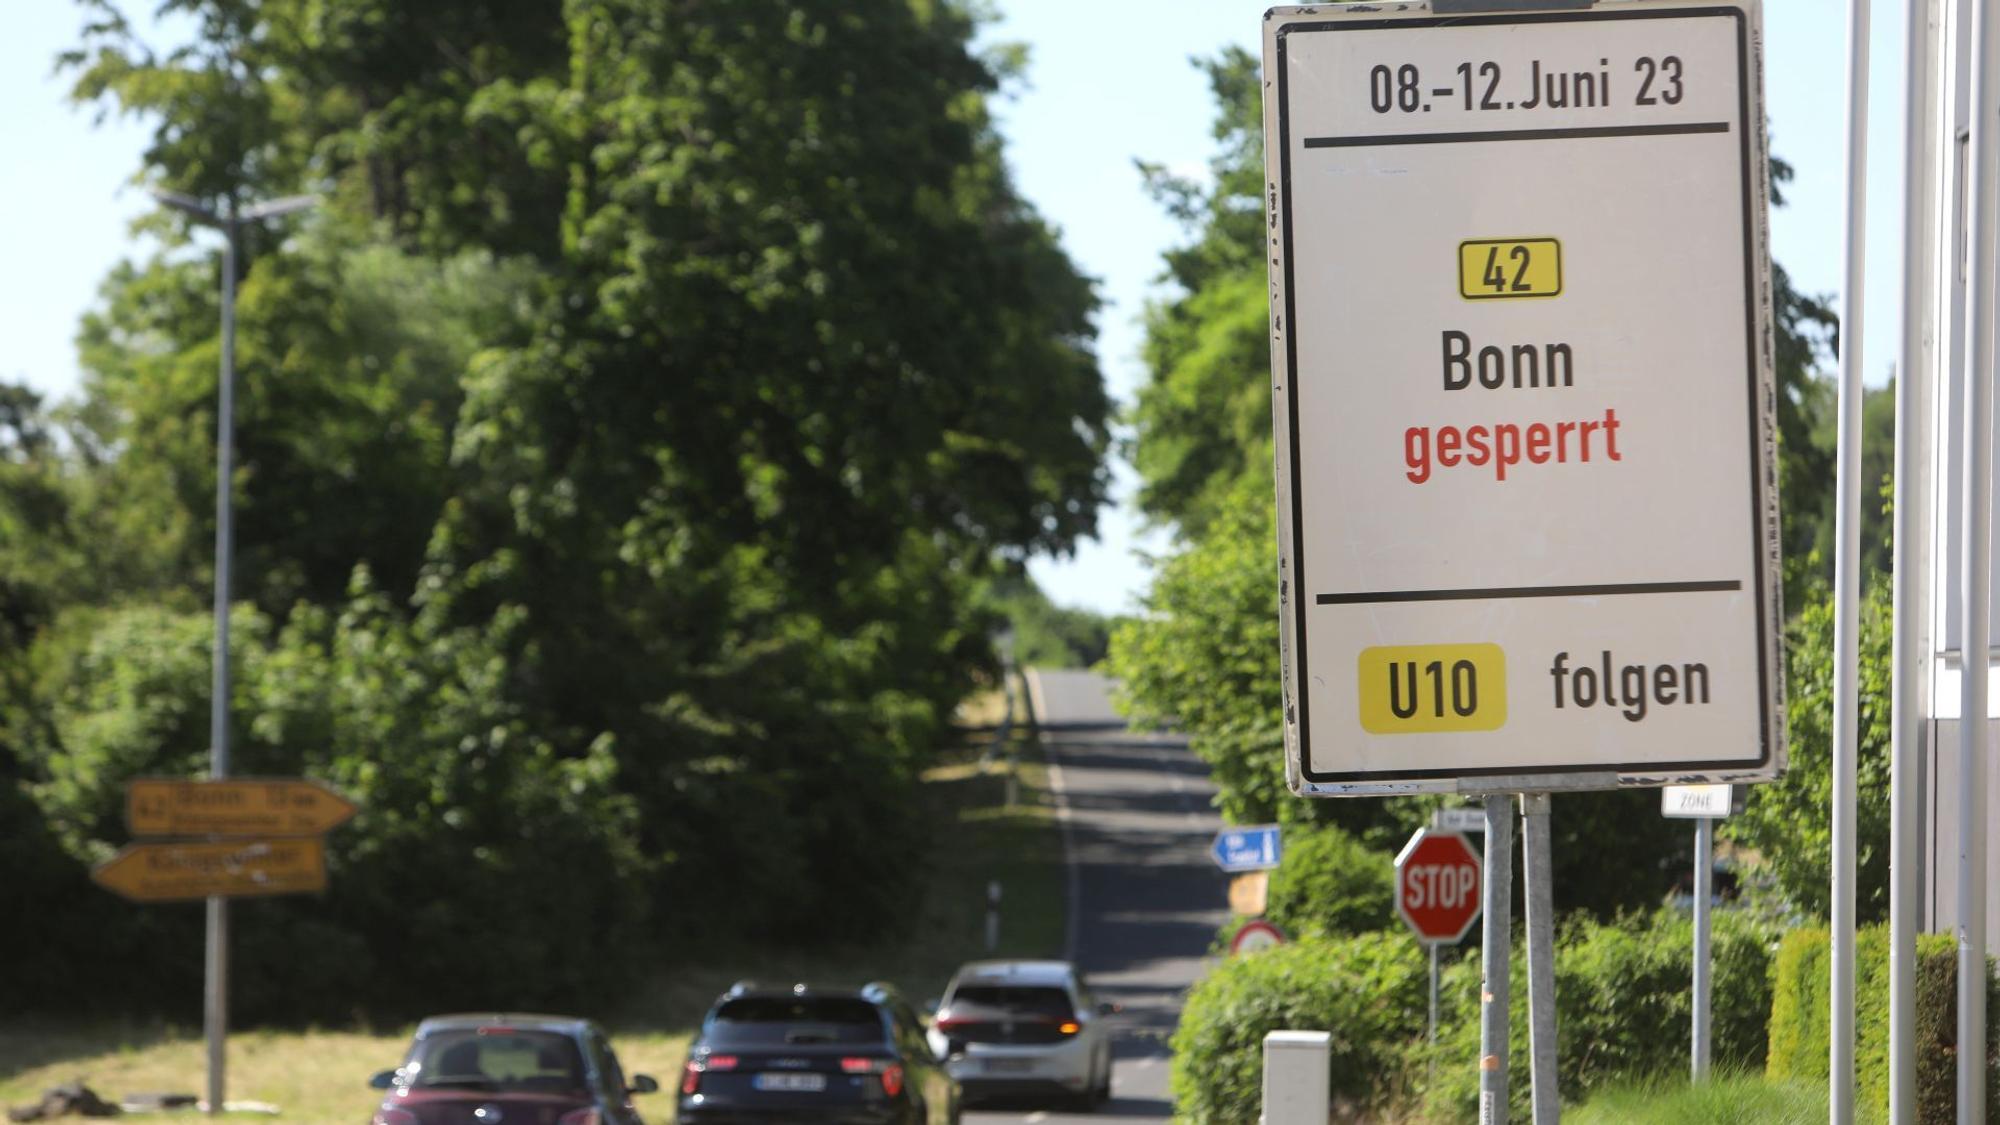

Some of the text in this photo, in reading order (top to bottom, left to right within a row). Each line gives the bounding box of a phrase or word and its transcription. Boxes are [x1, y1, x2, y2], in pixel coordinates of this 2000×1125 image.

[1635, 55, 1684, 106] 23
[1482, 245, 1532, 293] 42
[1442, 330, 1574, 391] Bonn
[1404, 409, 1622, 484] gesperrt
[1388, 650, 1710, 722] U10 folgen
[1680, 792, 1713, 809] ZONE
[1405, 864, 1476, 909] STOP
